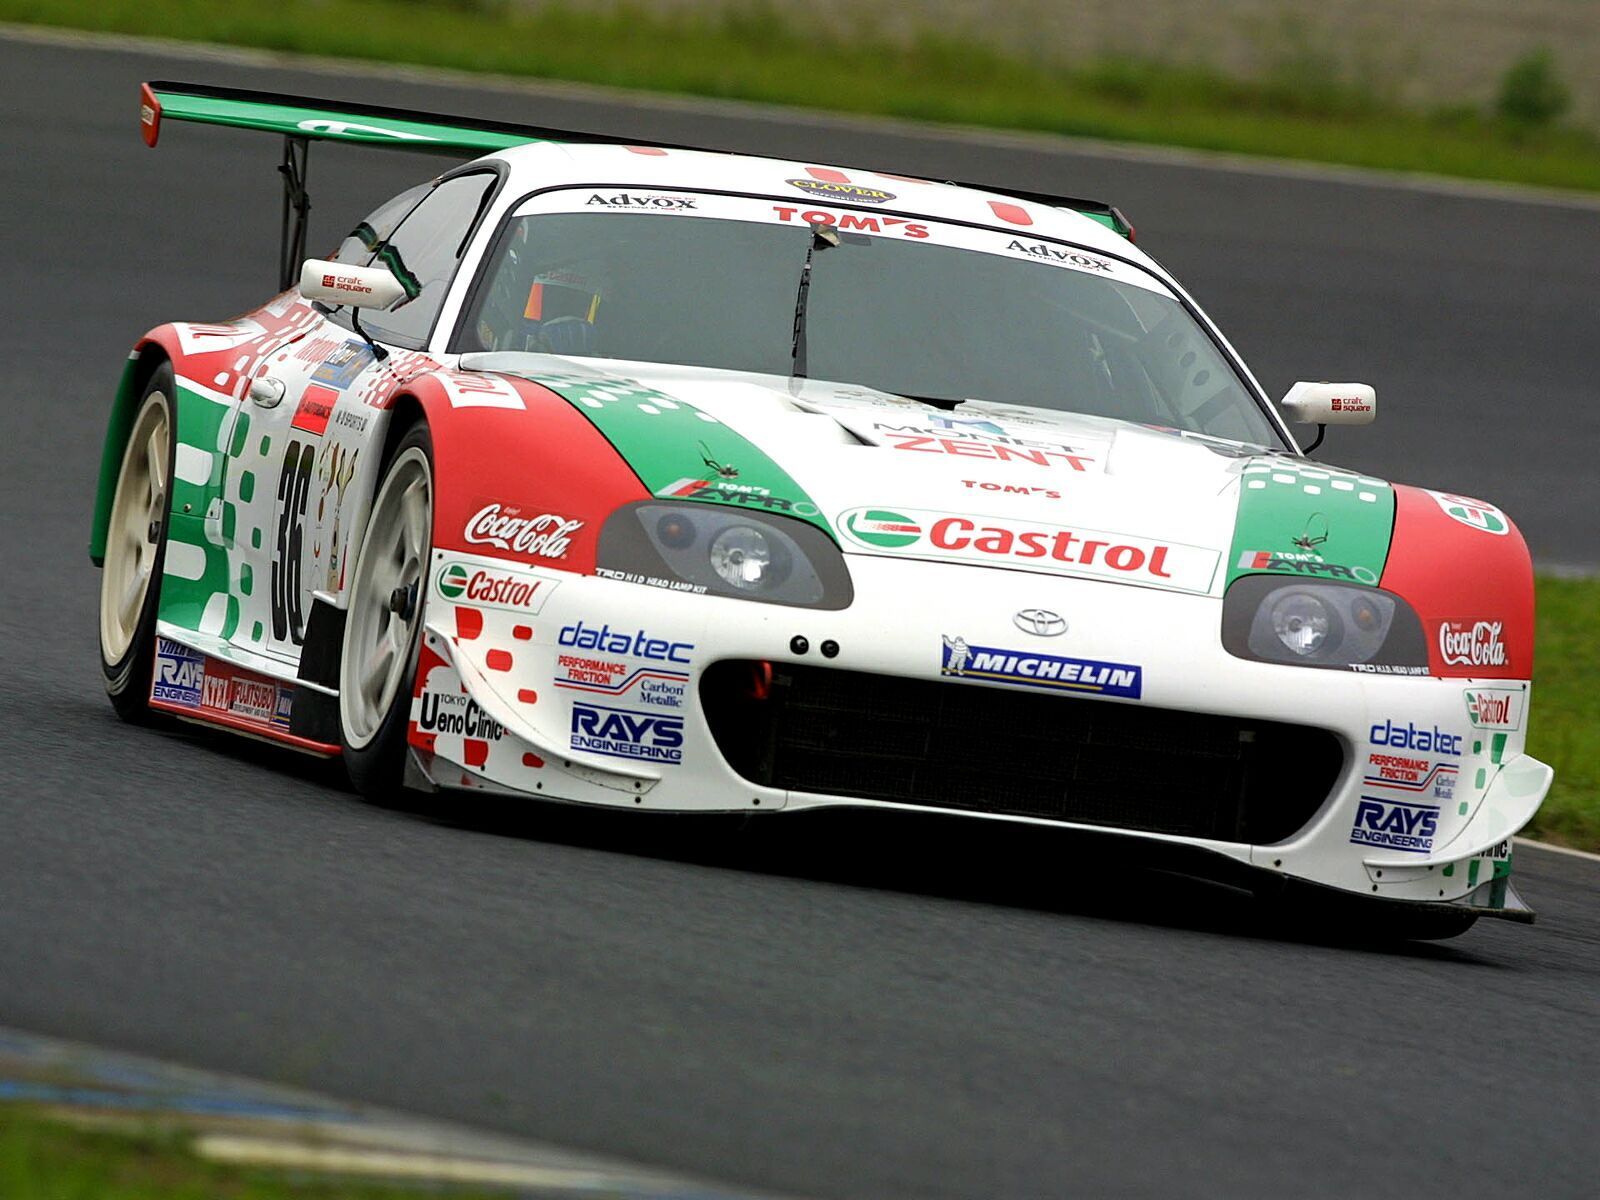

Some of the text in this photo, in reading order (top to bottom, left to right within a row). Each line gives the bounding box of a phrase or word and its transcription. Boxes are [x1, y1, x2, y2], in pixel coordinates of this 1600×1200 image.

[585, 192, 699, 211] Advox
[792, 180, 890, 199] CLOVER
[773, 206, 930, 239] TOM'S
[1005, 239, 1114, 273] Advox
[336, 283, 372, 294] square
[1343, 404, 1371, 412] square
[873, 423, 1085, 453] MONET
[885, 434, 1095, 471] ZENT
[961, 480, 1061, 498] TOM'S
[464, 504, 584, 558] Coca-Cola
[929, 517, 1171, 578] Castrol
[467, 571, 541, 607] Castrol
[646, 577, 668, 588] HEAD
[558, 621, 695, 664] datatec
[1440, 622, 1505, 665] Coca-Cola
[155, 658, 204, 689] RAYS
[558, 655, 626, 675] PERFORMANCE
[568, 669, 611, 684] FRICTION
[972, 652, 1135, 687] MICHELIN
[440, 693, 466, 706] TOKYO
[640, 692, 682, 708] Metallic
[641, 680, 684, 696] Carbon
[571, 706, 684, 748] RAYS
[1369, 719, 1463, 756] datatec
[570, 734, 682, 760] ENGINEERING
[1369, 753, 1429, 772] PERFORMANCE
[1379, 767, 1418, 781] FRICTION
[1354, 801, 1440, 837] RAYS
[1350, 828, 1433, 849] ENGINEERING
